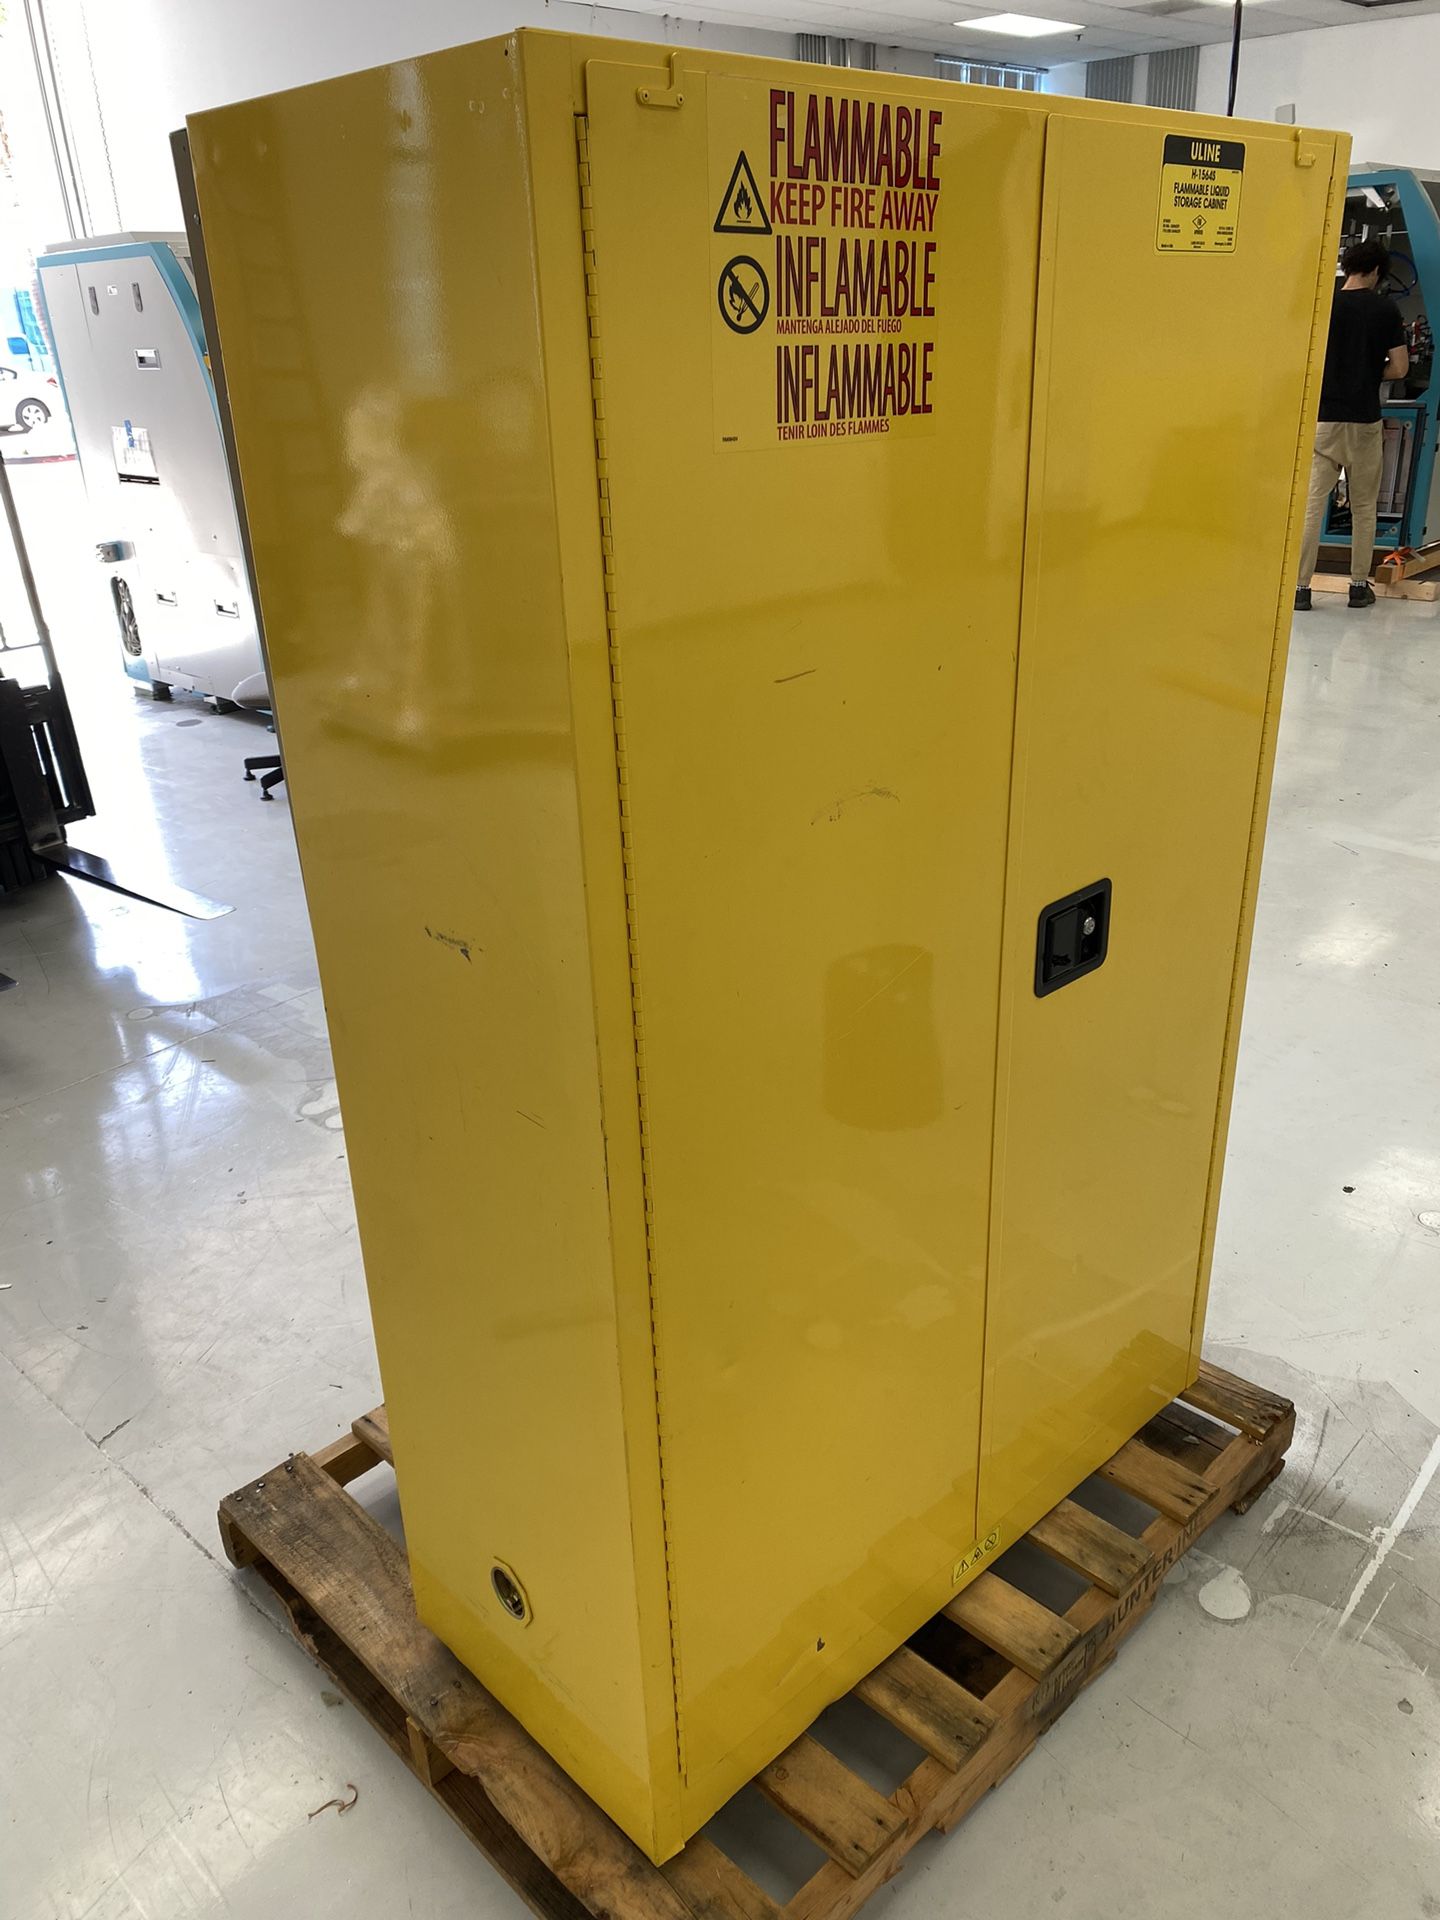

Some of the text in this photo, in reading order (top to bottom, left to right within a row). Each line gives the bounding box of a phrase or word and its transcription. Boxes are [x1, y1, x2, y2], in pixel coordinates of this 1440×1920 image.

[770, 89, 942, 191] FLAMMABLE
[1190, 141, 1221, 163] ULINE
[1173, 182, 1230, 197] FLAMMABLE LIQUID
[770, 181, 939, 232] KEEP FIRE AWAY
[1173, 196, 1228, 210] STORAGE CABINET
[776, 235, 937, 317] INFLAMABLE
[776, 320, 902, 334] MANTENGA ALEJADO DEL FUEGO
[776, 342, 934, 424] INFLAMMABLE
[777, 418, 890, 441] TENIR LOIN DES FLAMMES
